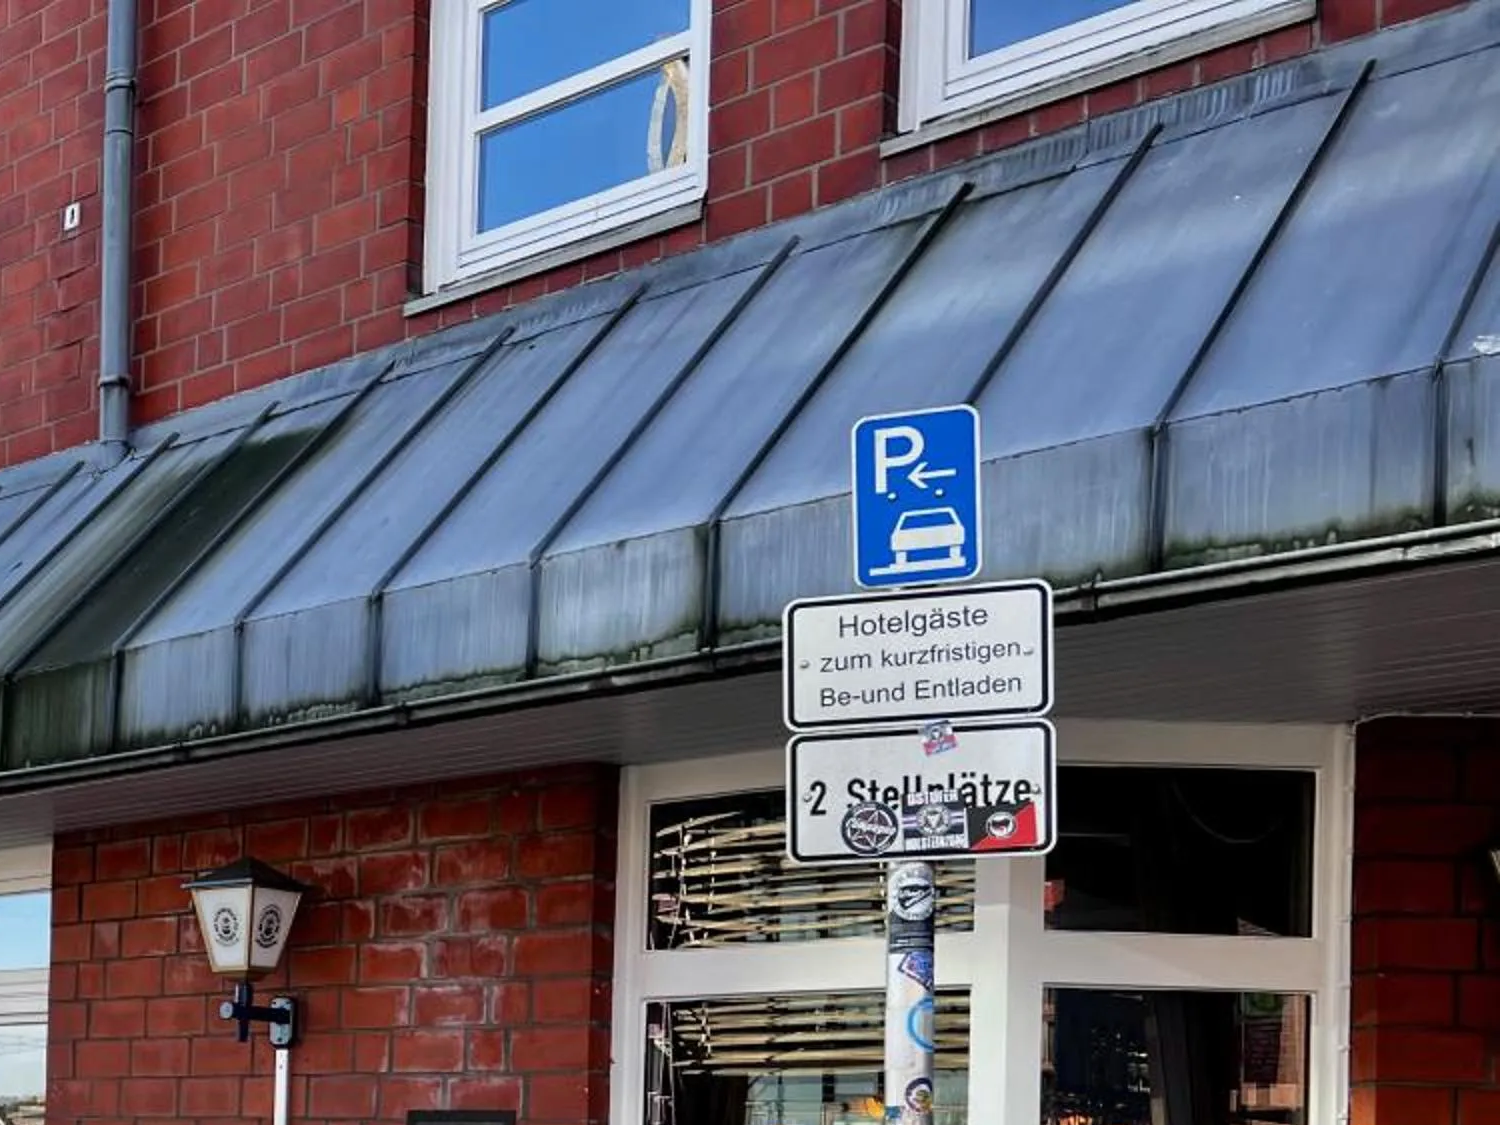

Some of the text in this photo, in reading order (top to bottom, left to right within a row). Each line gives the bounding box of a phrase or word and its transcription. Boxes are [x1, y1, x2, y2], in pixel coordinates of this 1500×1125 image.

[874, 426, 925, 494] P
[838, 605, 988, 638] Hotelgäste
[820, 641, 1021, 673] zum kurzfristigen
[820, 675, 1022, 708] Be-und Entladen
[809, 780, 827, 816] 2
